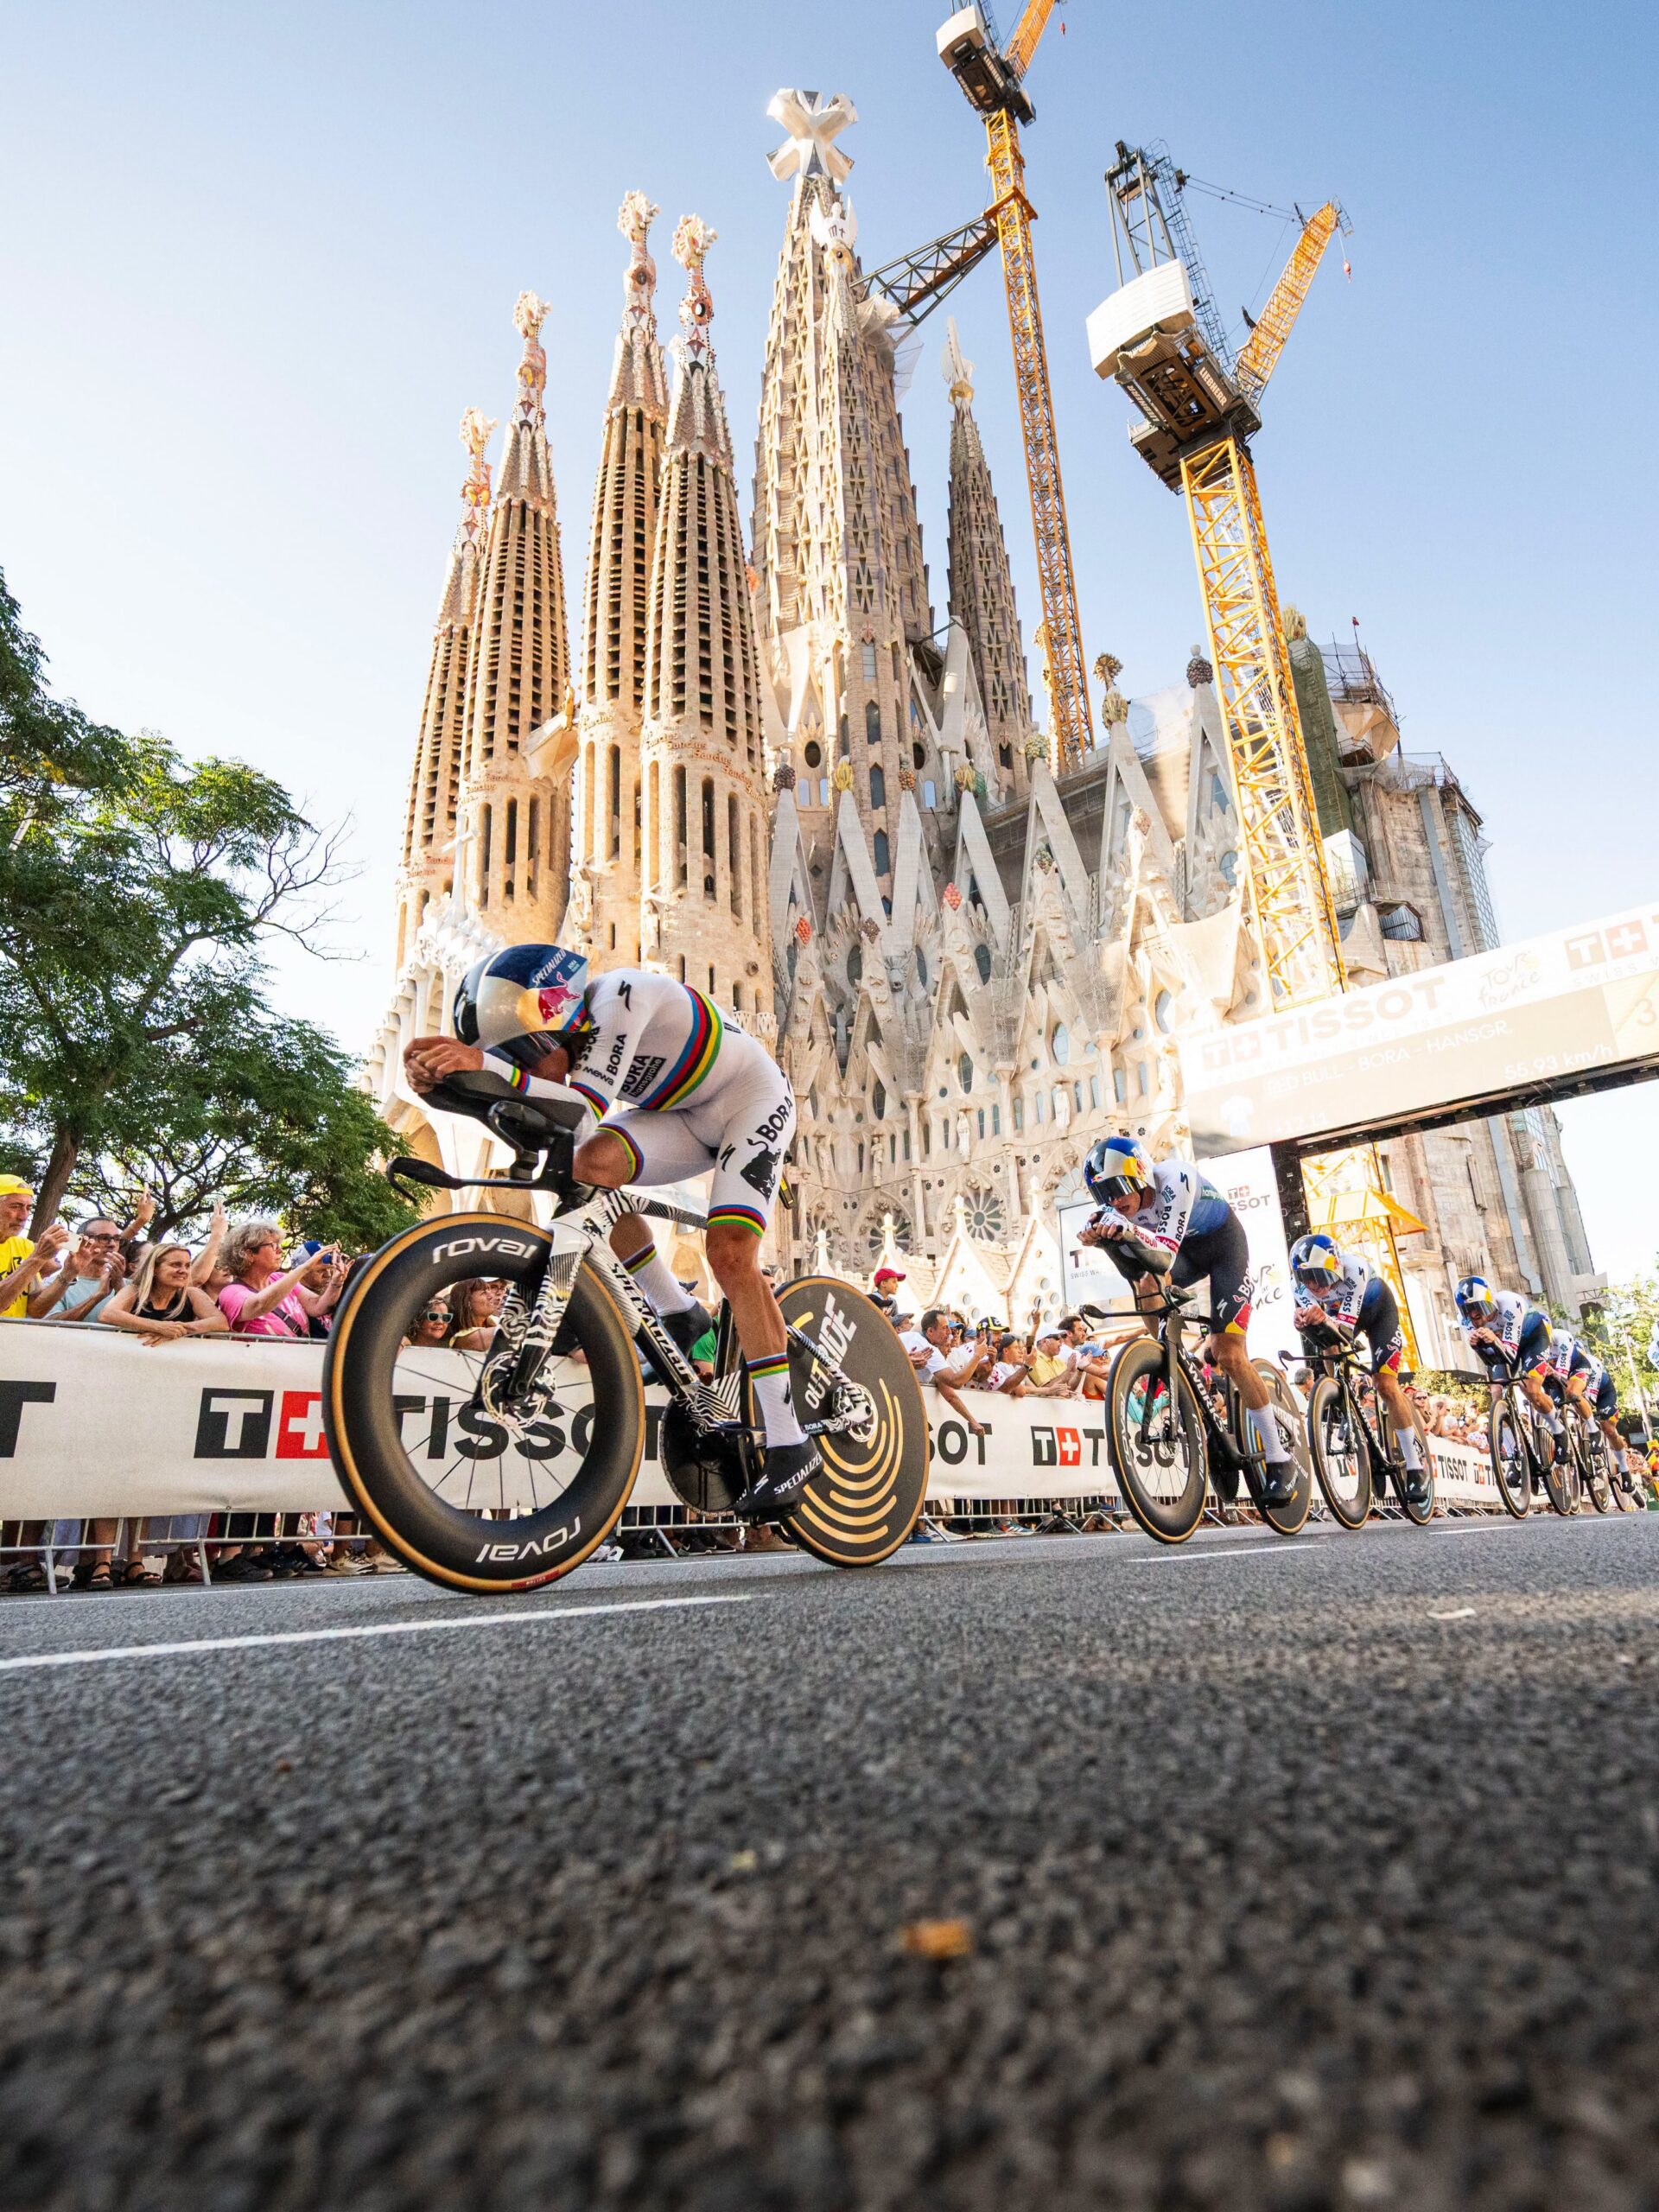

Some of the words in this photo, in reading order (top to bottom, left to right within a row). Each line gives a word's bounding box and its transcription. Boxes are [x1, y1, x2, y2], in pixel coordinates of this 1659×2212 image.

[1198, 366, 1228, 407] LIEBHERR
[1266, 975, 1446, 1052] TISSOT
[606, 1033, 627, 1077] BORA
[1303, 1064, 1344, 1086] BULL
[1358, 1048, 1412, 1071] BORA
[1426, 1020, 1514, 1053] HANSGR.
[1504, 1055, 1558, 1080] 55.93
[1562, 1042, 1614, 1068] km/h
[582, 1066, 614, 1086] mewa
[632, 1058, 664, 1096] hansgrohe
[755, 1095, 793, 1143] BORA
[1158, 1205, 1173, 1234] BOSS
[1229, 1194, 1271, 1211] SSOT
[1175, 1211, 1186, 1242] BORA
[432, 1237, 539, 1264] roval
[1343, 1291, 1354, 1313] BOSS
[1504, 1322, 1514, 1340] BOSS
[1438, 1455, 1468, 1482] TISSOT
[475, 1516, 582, 1563] roval
